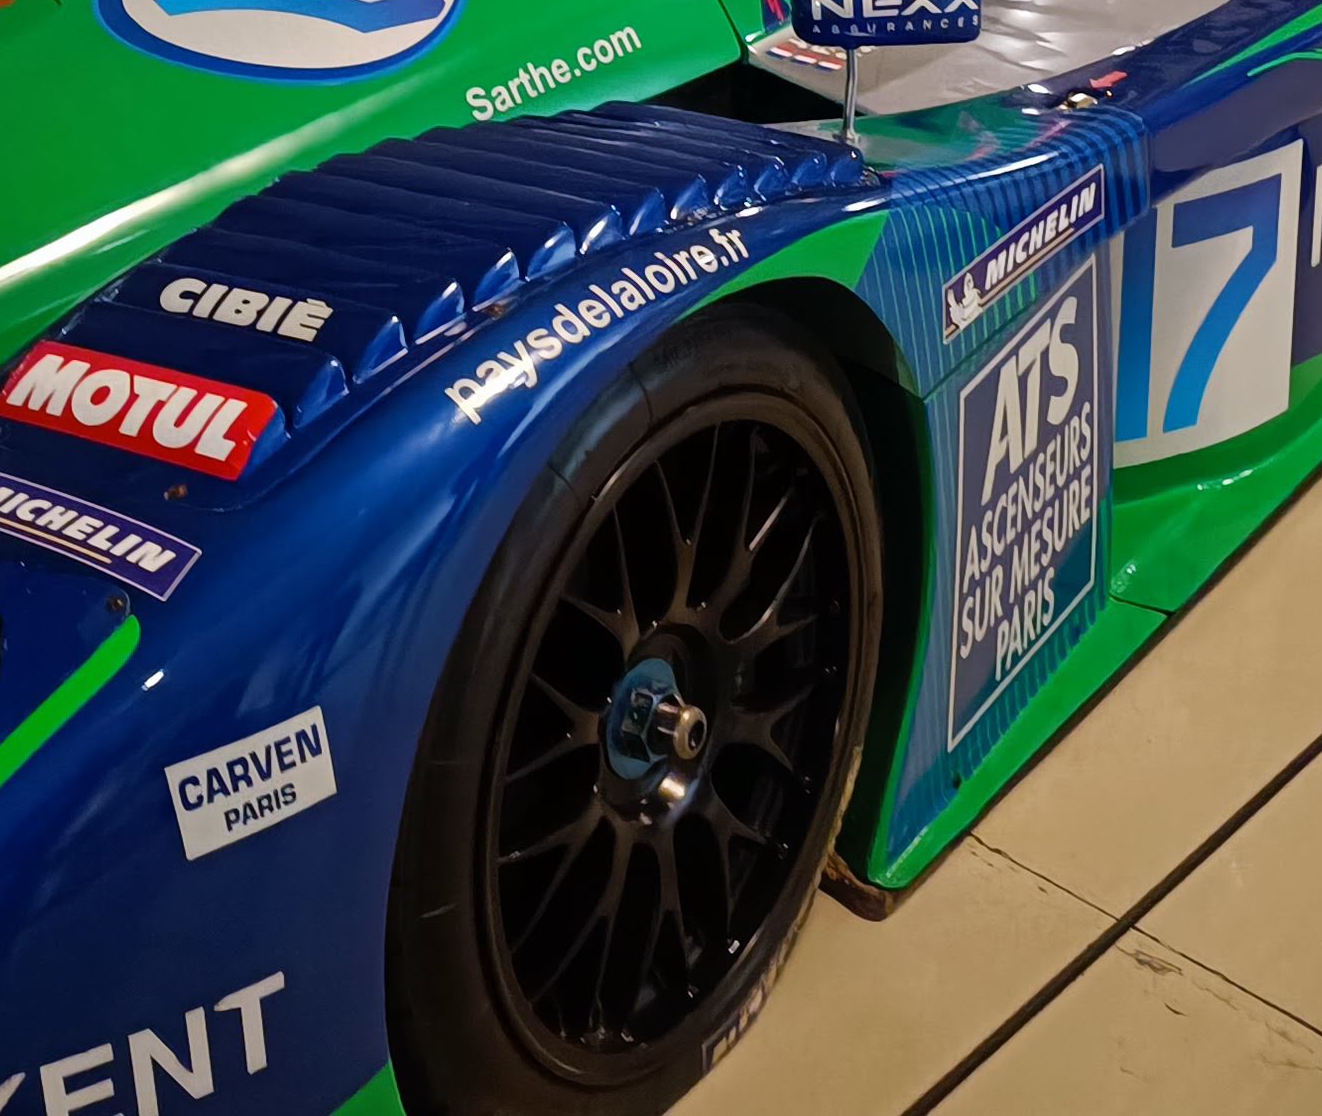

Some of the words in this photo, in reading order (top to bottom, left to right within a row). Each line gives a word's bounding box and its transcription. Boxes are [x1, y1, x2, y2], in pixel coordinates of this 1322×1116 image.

[465, 24, 642, 123] Sarthe.com
[812, 14, 980, 35] ASSURANCES
[984, 182, 1097, 292] MICHELIN
[444, 224, 752, 425] paysdelaloire.fr
[1115, 172, 1283, 443] 17
[5, 353, 252, 462] MOTUL
[981, 295, 1080, 507] ATS
[962, 400, 1092, 595] ASCENSEURS
[960, 571, 1005, 659] SUR
[1008, 478, 1093, 599] MESURE
[994, 565, 1057, 683] PARIS
[177, 722, 324, 813] CARVEN
[223, 783, 298, 834] PARIS
